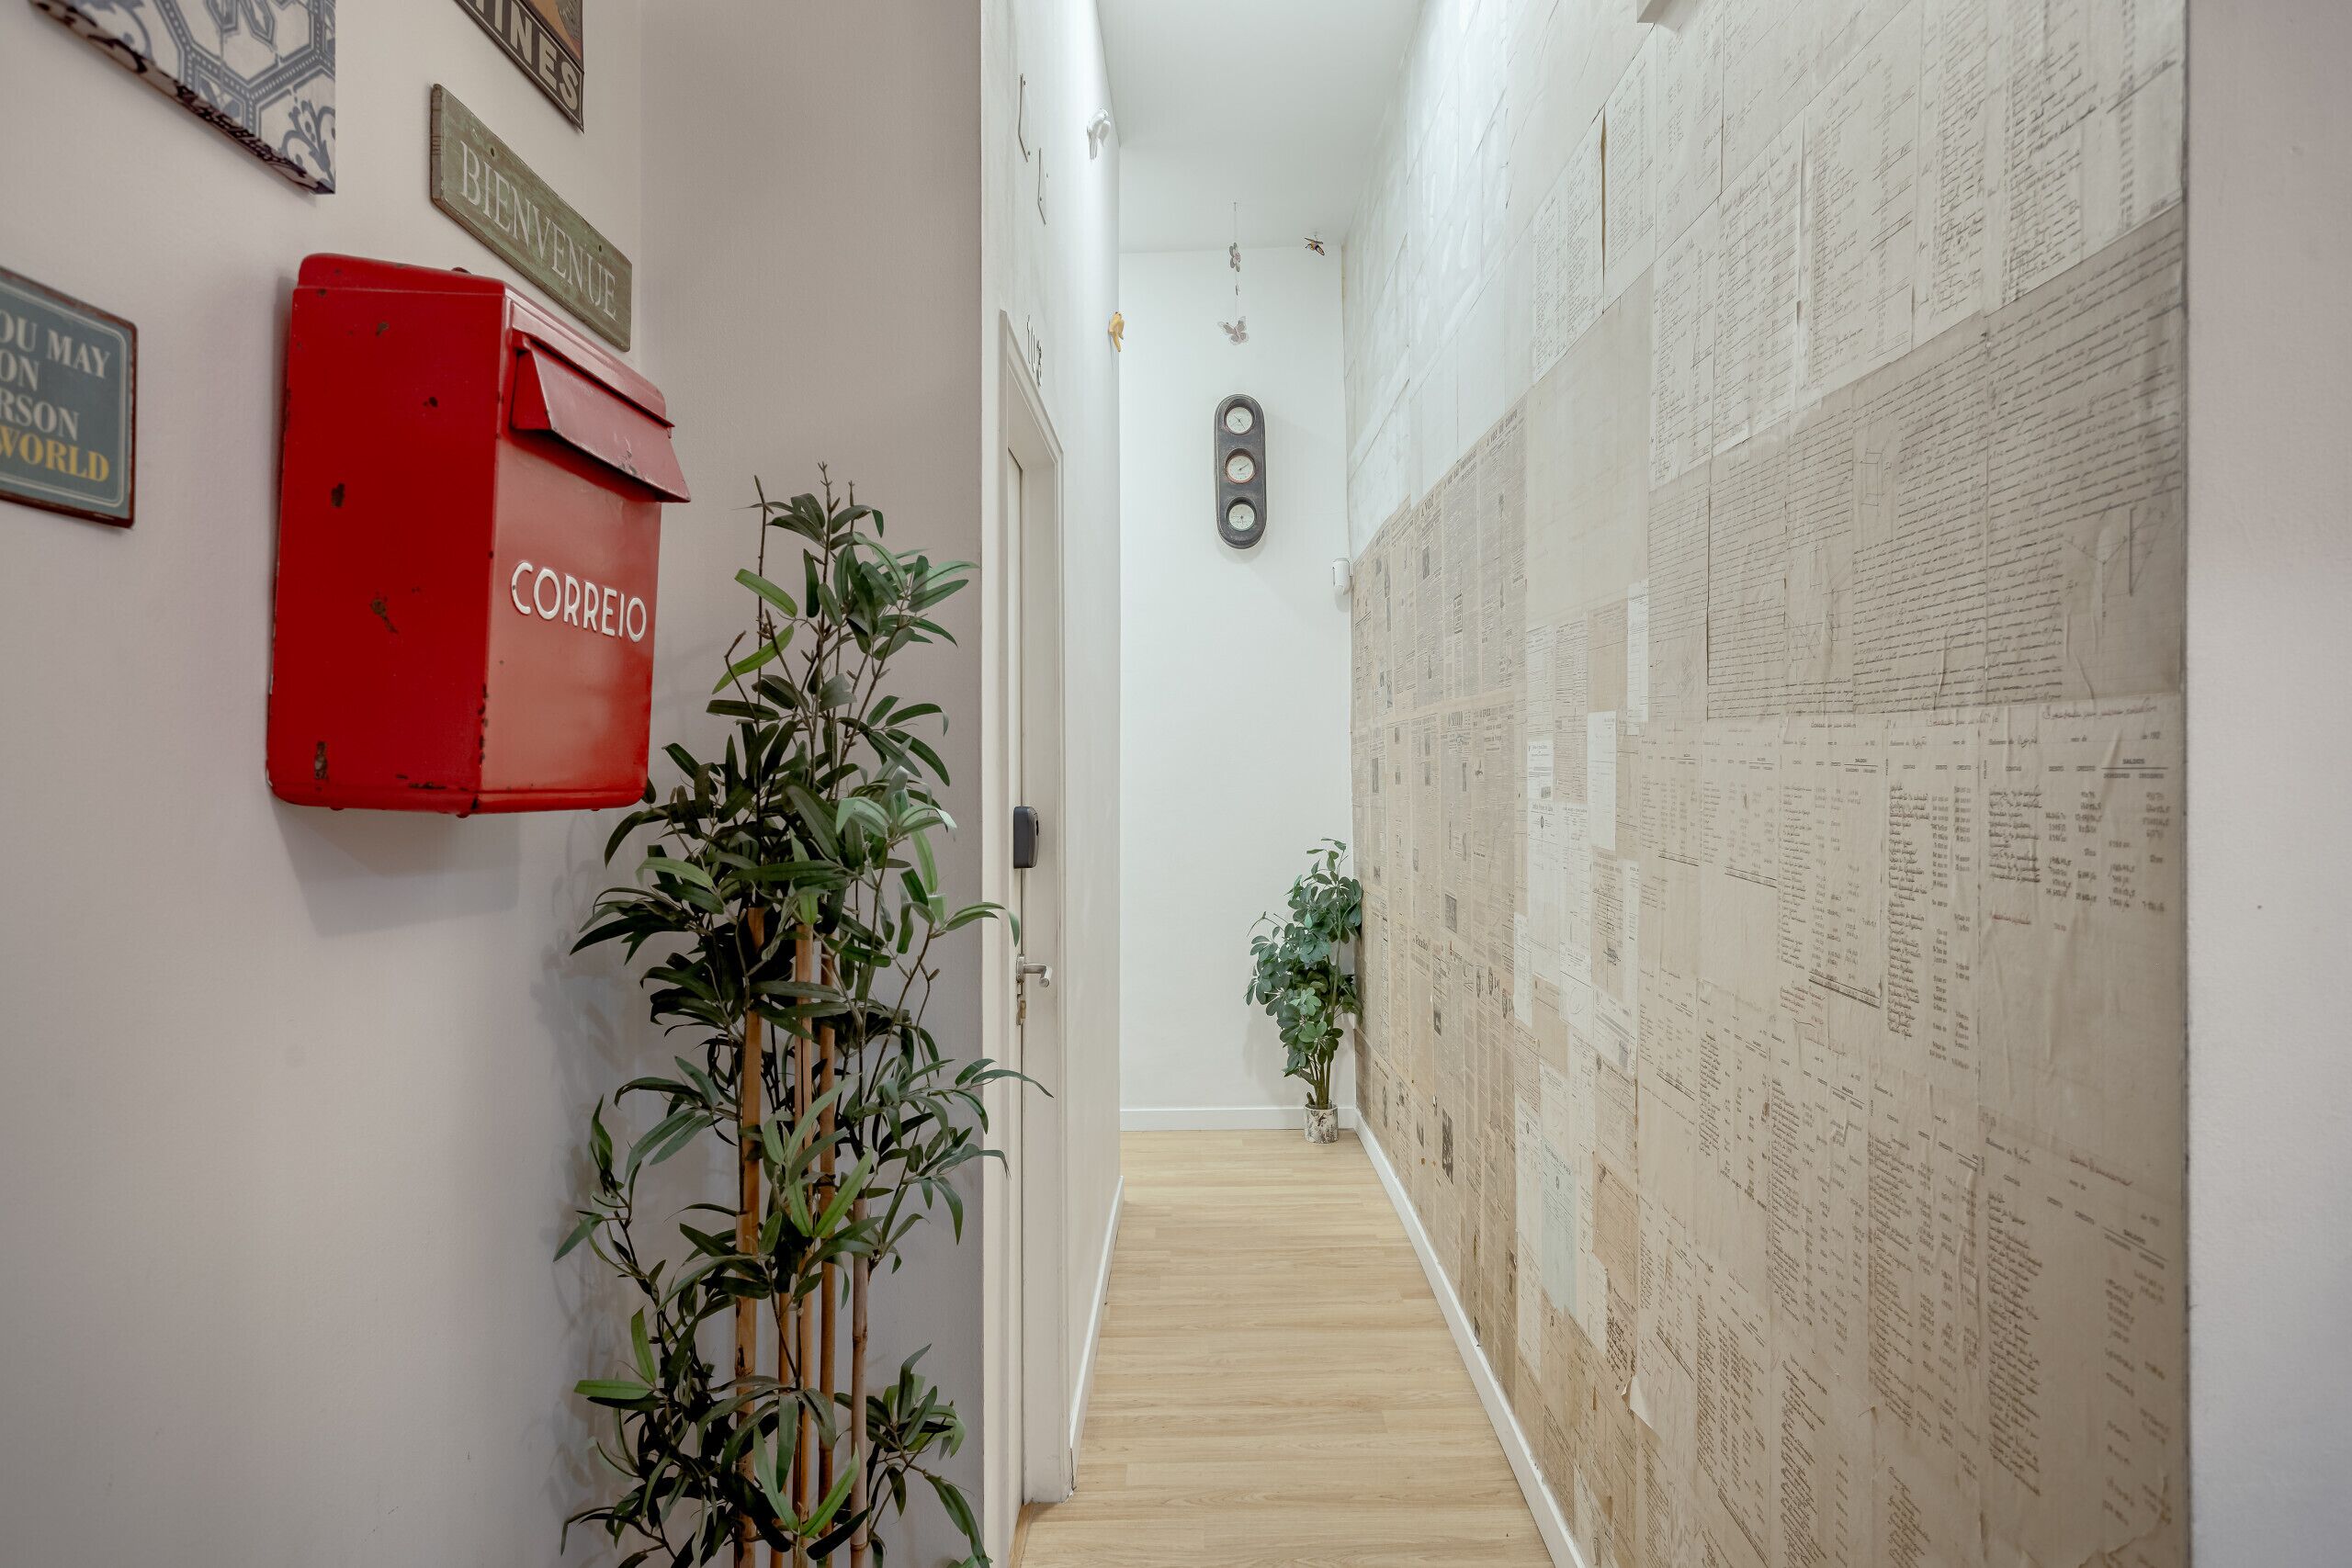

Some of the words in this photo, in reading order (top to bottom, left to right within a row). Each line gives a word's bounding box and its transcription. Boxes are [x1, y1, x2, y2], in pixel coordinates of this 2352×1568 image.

[475, 0, 579, 110] INES
[460, 141, 616, 321] BIENVENUE
[47, 329, 110, 379] MAY
[511, 561, 647, 642] CORREIO
